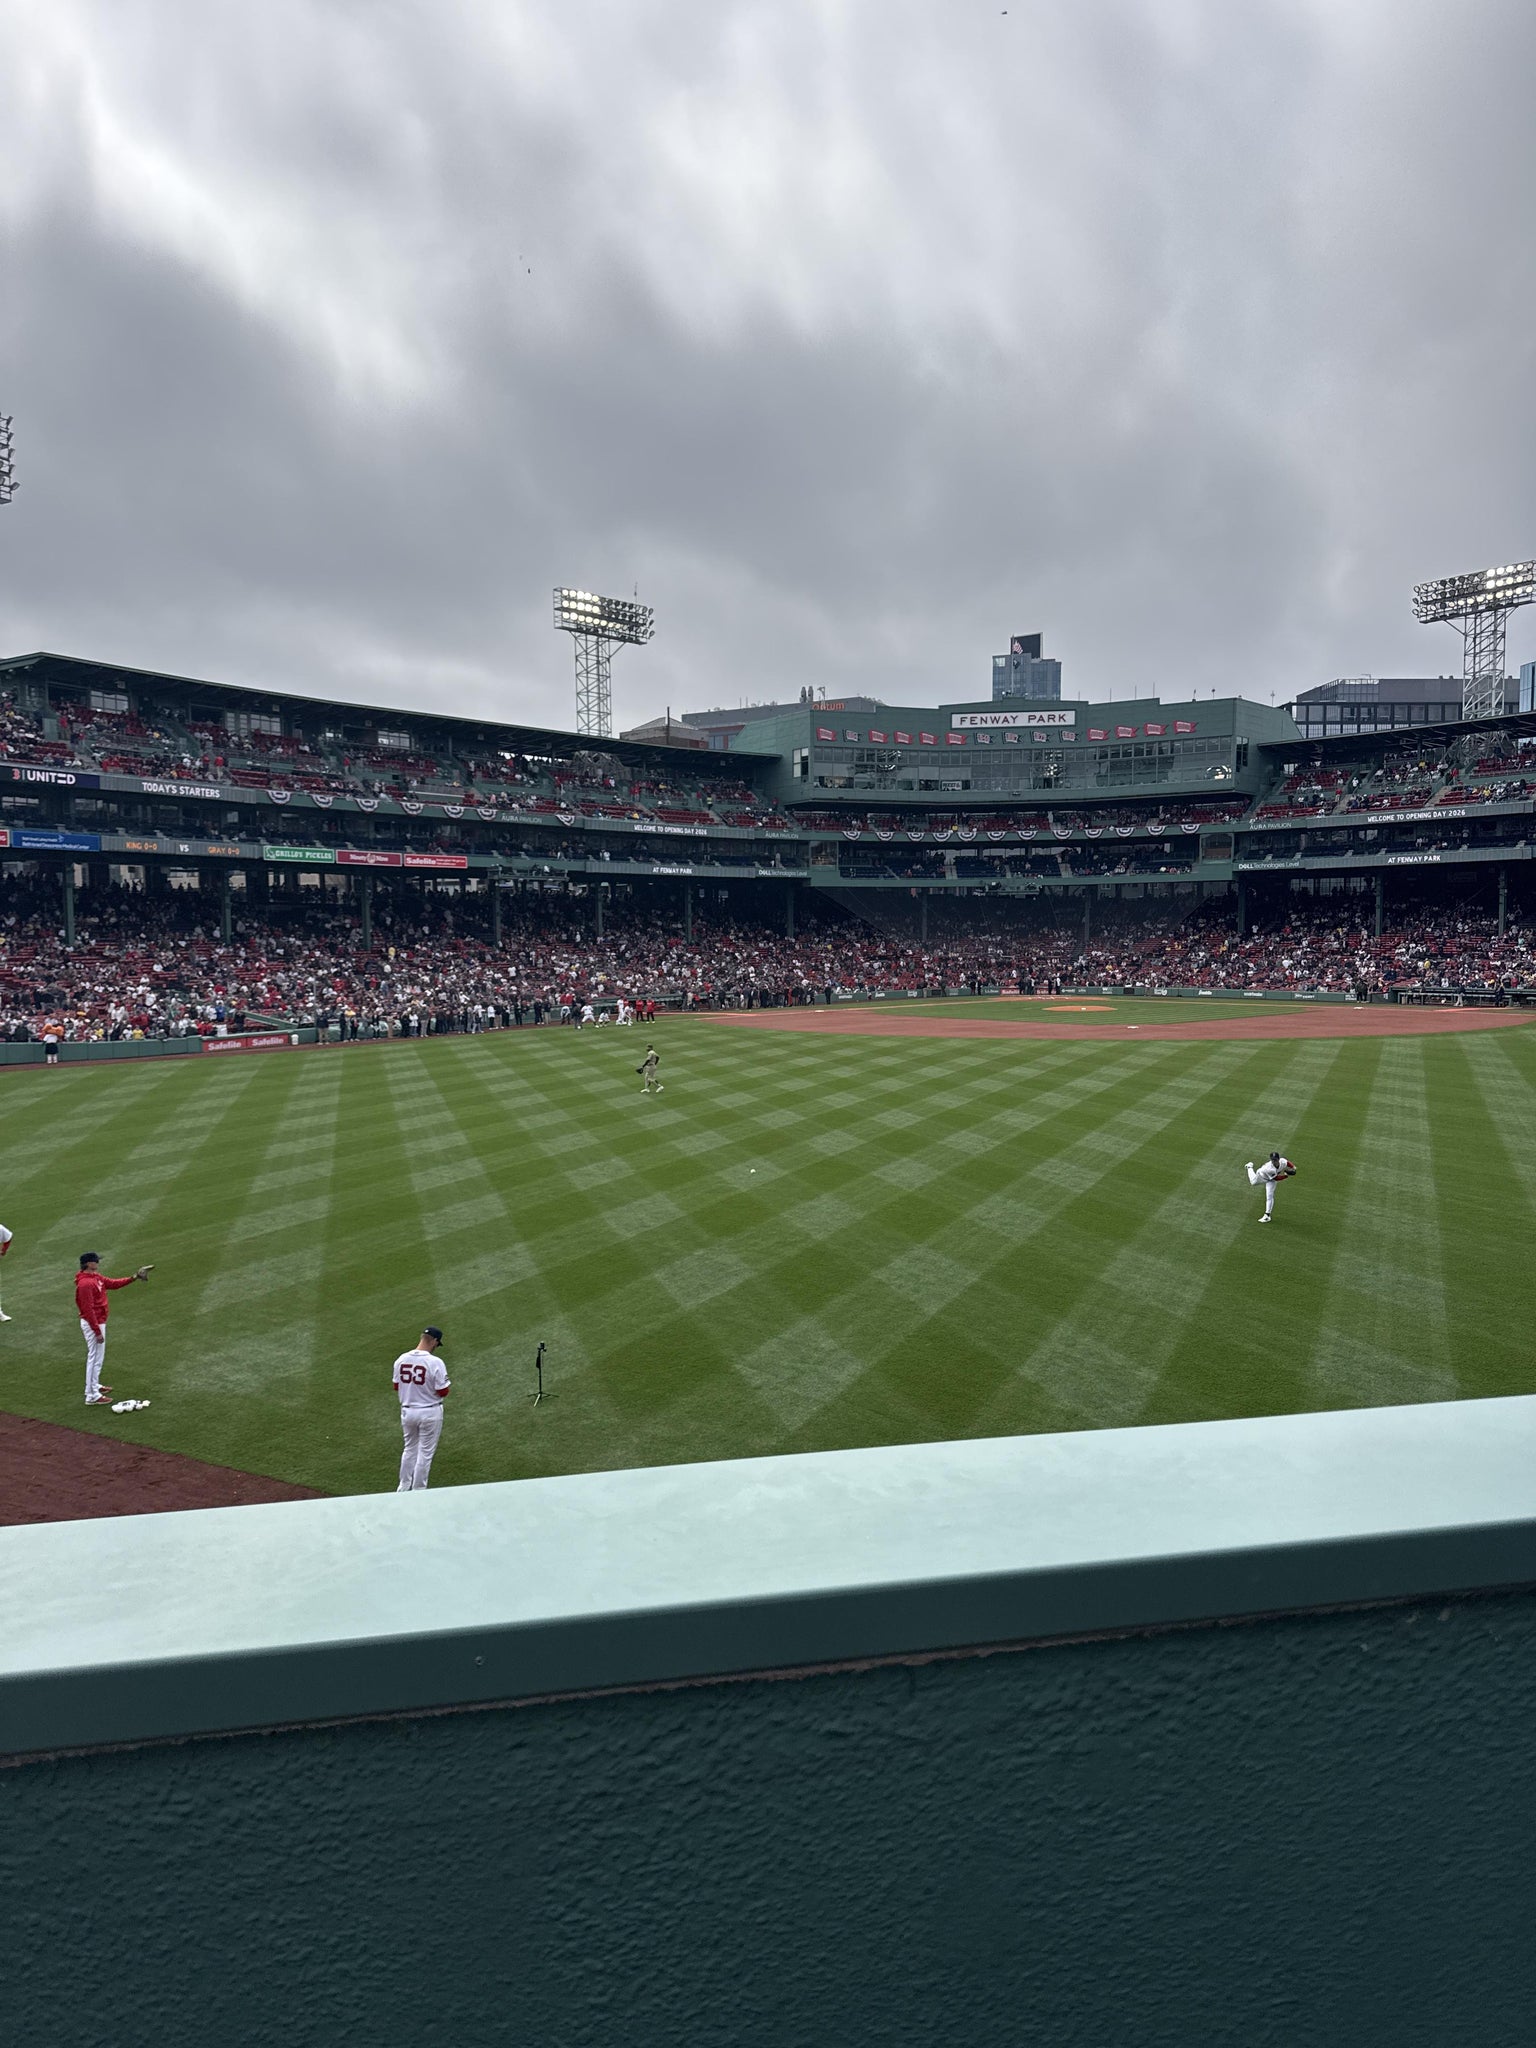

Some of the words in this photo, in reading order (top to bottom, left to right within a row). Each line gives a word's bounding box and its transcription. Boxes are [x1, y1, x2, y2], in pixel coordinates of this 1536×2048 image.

[960, 715, 1018, 725] FENWAY
[1028, 714, 1066, 723] PARK
[27, 770, 76, 785] UNITED
[142, 782, 178, 794] TODAY'S
[179, 786, 220, 798] STARTERS
[519, 815, 542, 824] PAVILION
[1406, 812, 1431, 820] OPENING
[1433, 810, 1446, 818] DAY
[634, 824, 656, 832] WELCOME
[665, 826, 683, 834] OPENING
[695, 828, 708, 836] 2026
[126, 842, 142, 850] KING
[179, 844, 189, 852] VS
[208, 846, 225, 854] GRAY
[305, 852, 332, 860] PICKLES
[1424, 854, 1441, 862] PARK
[406, 857, 436, 865] Safelite
[208, 1041, 242, 1051] Safelite
[252, 1037, 284, 1046] Safelite
[400, 1363, 427, 1385] 53
